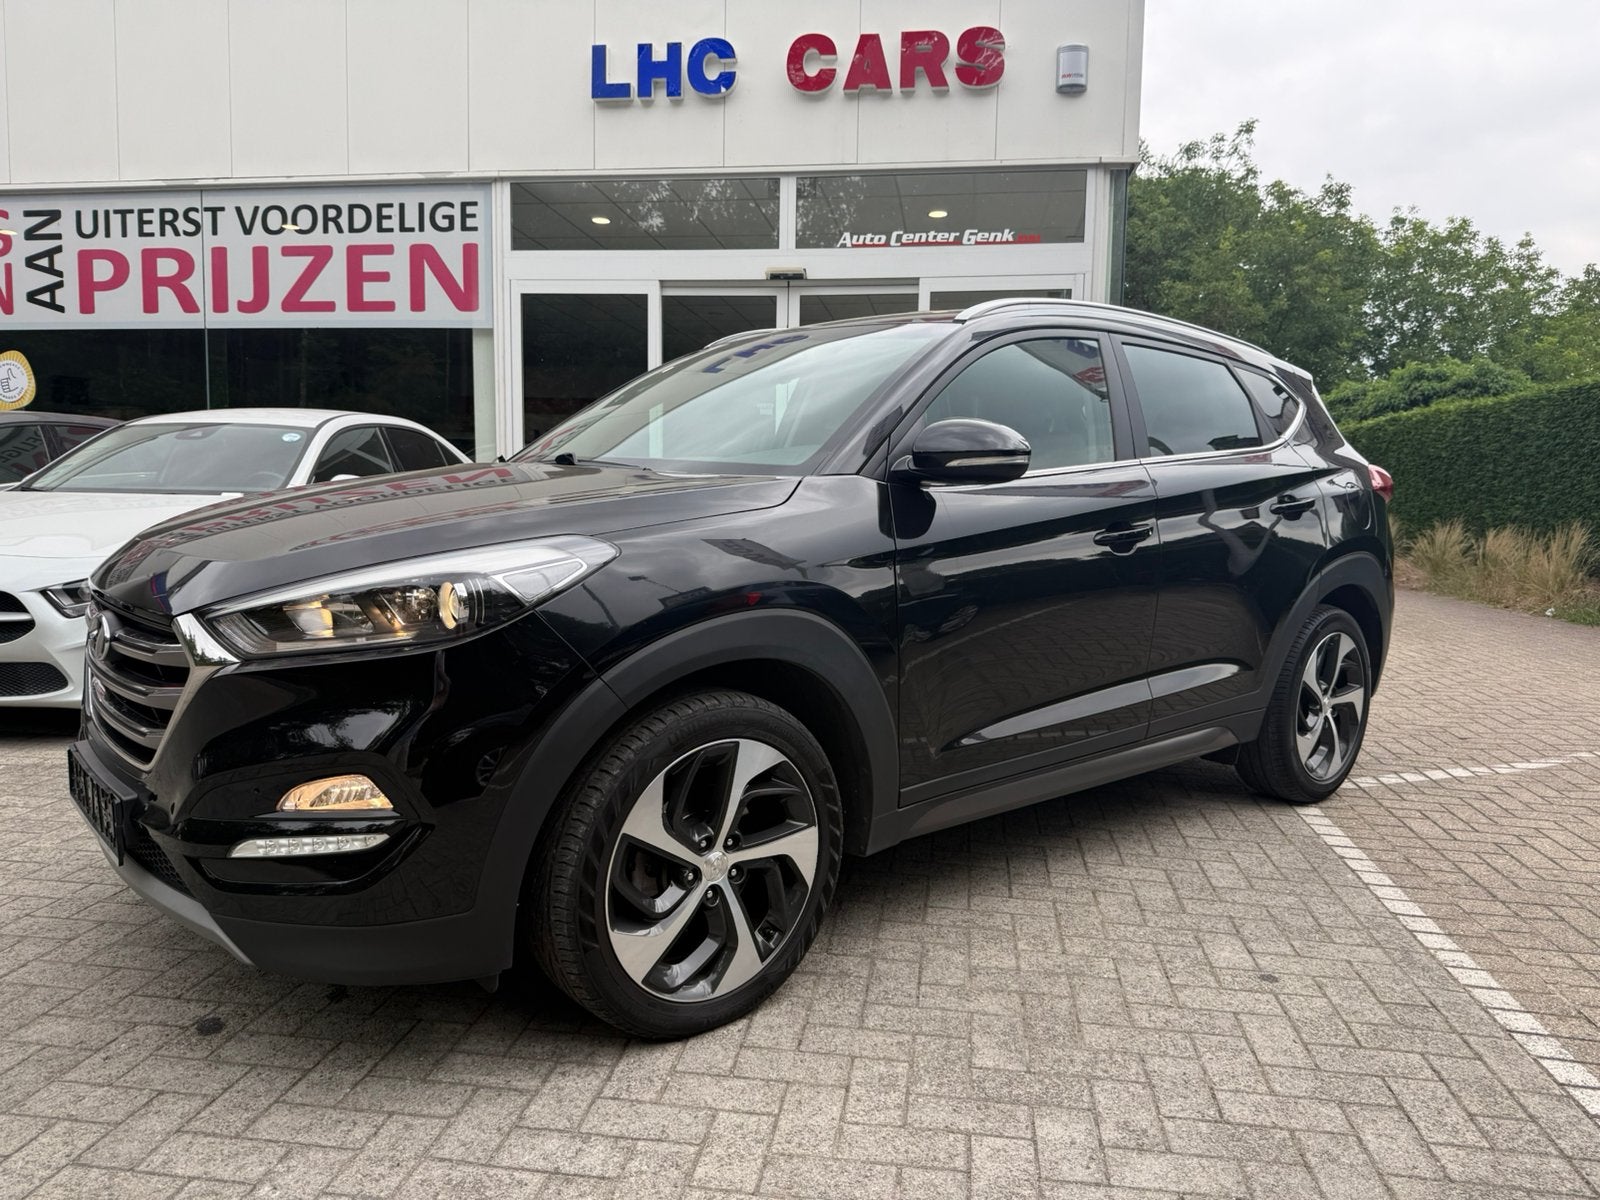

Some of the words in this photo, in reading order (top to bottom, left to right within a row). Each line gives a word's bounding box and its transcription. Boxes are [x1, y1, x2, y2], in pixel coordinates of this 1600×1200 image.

[591, 37, 737, 100] LHC
[786, 26, 1006, 95] CARS
[75, 206, 225, 238] UITERST
[235, 201, 479, 236] VOORDELIGE
[837, 231, 886, 247] Auto
[890, 230, 959, 246] Center
[962, 228, 1015, 245] Genk
[23, 209, 65, 313] AAN
[77, 243, 479, 314] PRIJZEN
